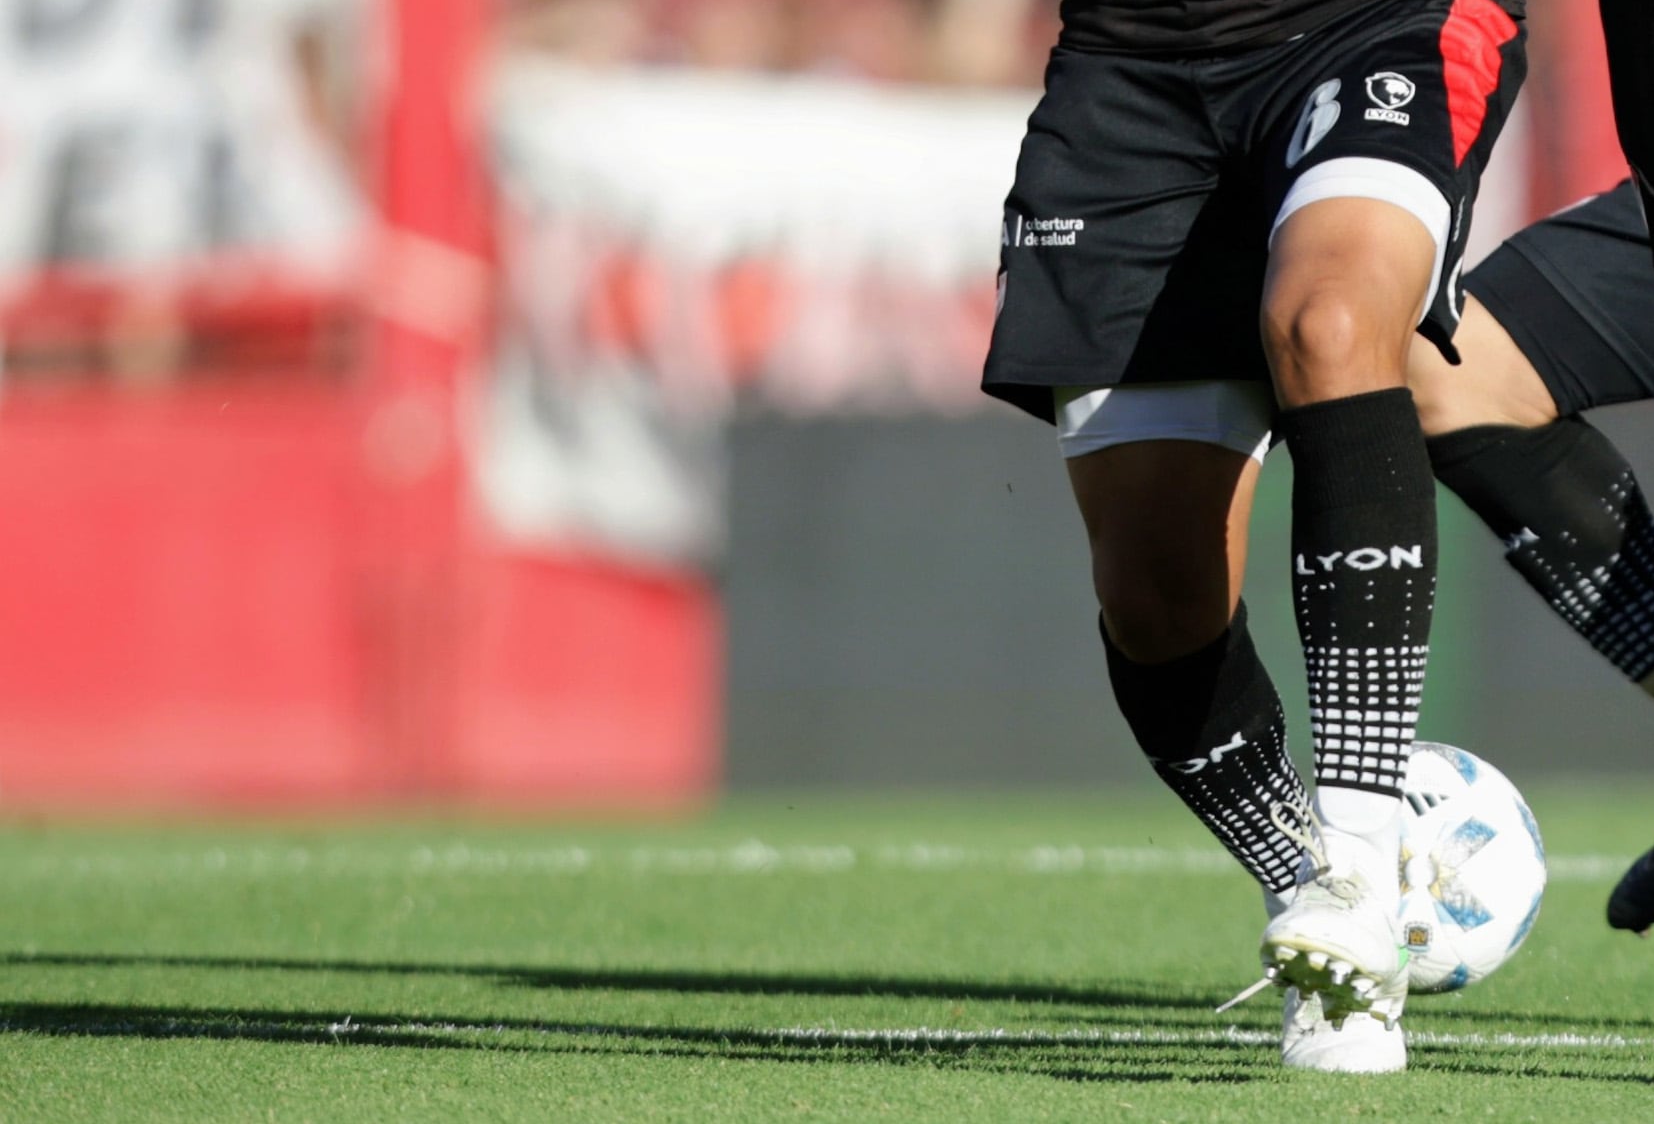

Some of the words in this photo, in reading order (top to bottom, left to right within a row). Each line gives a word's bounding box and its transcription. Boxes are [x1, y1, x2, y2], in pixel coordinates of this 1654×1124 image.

[1366, 108, 1409, 124] LYON
[1040, 231, 1076, 246] salud
[1296, 544, 1423, 575] LYON
